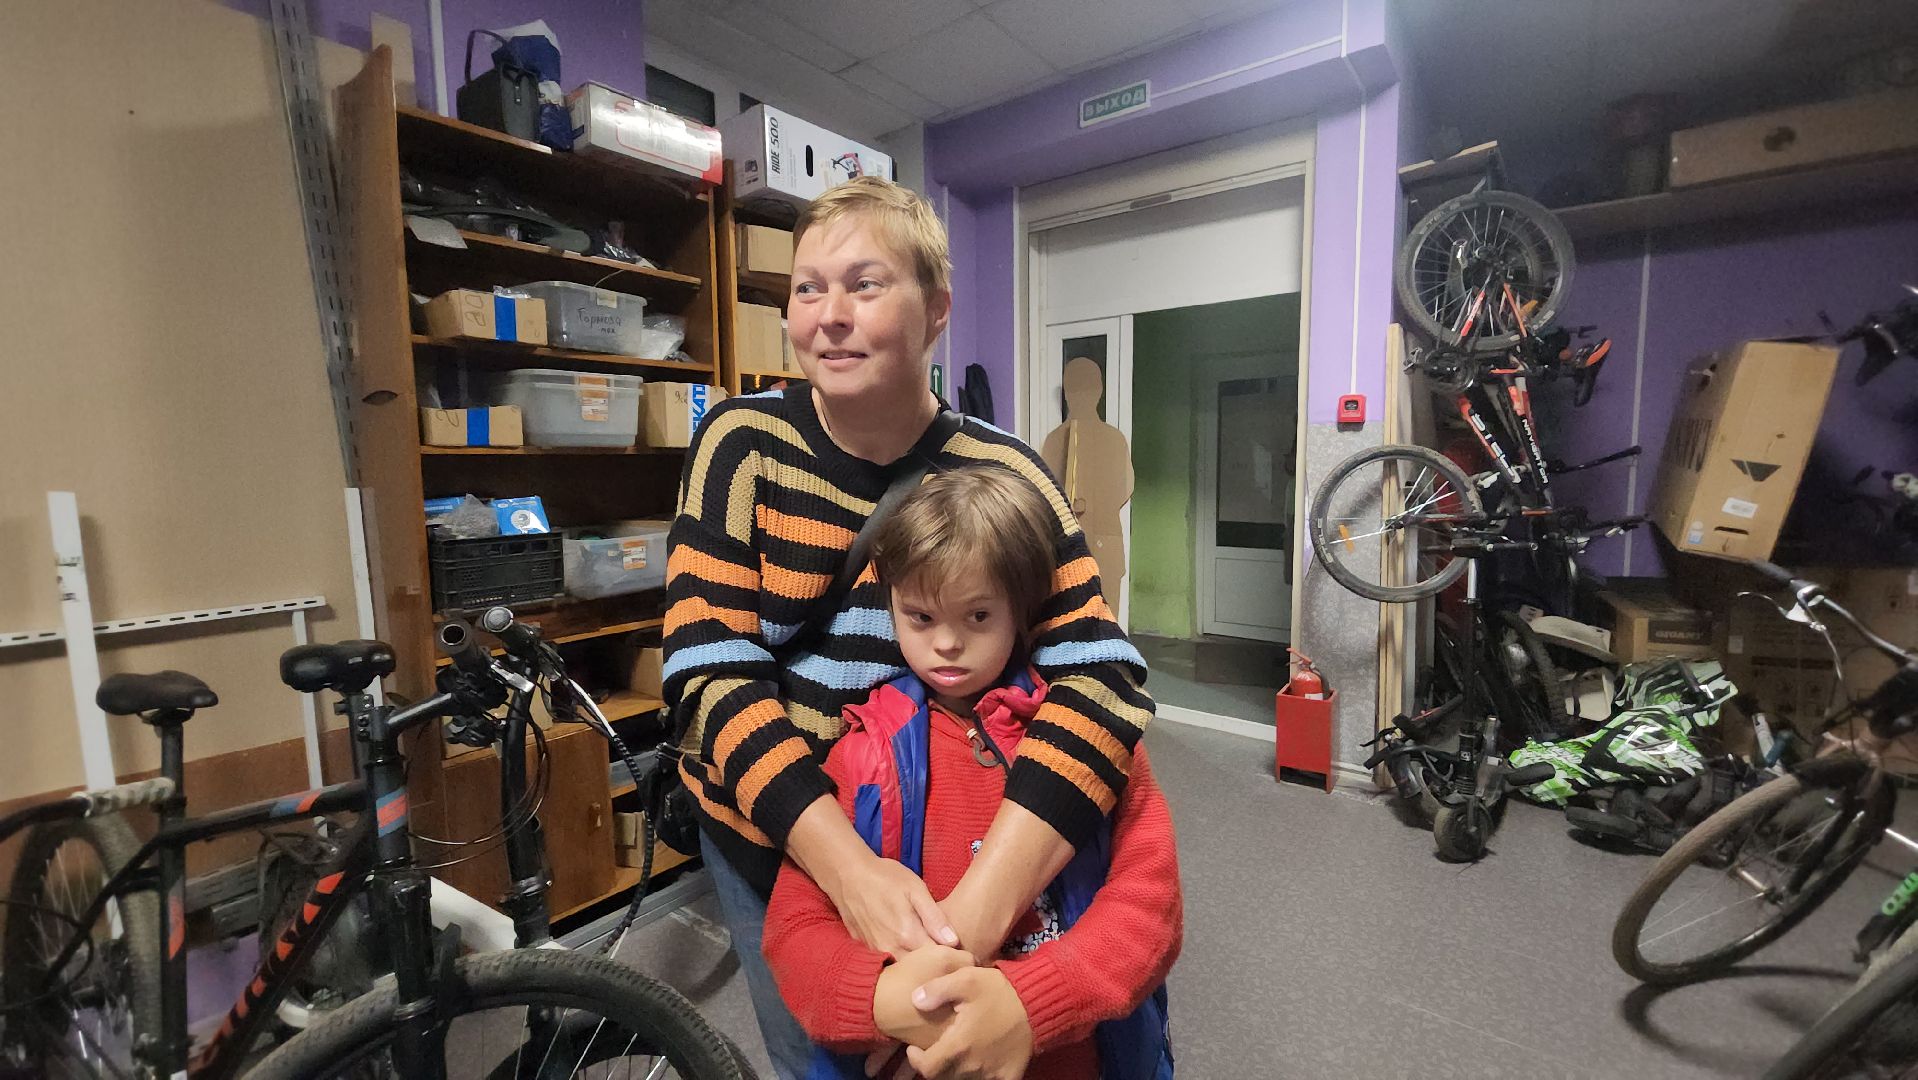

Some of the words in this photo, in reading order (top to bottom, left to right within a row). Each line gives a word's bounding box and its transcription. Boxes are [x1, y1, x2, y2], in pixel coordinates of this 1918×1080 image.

[1085, 87, 1145, 117] ВЫХОД
[769, 116, 779, 147] 500
[770, 149, 780, 174] RIDE
[1521, 418, 1549, 484] NAVIGATOR
